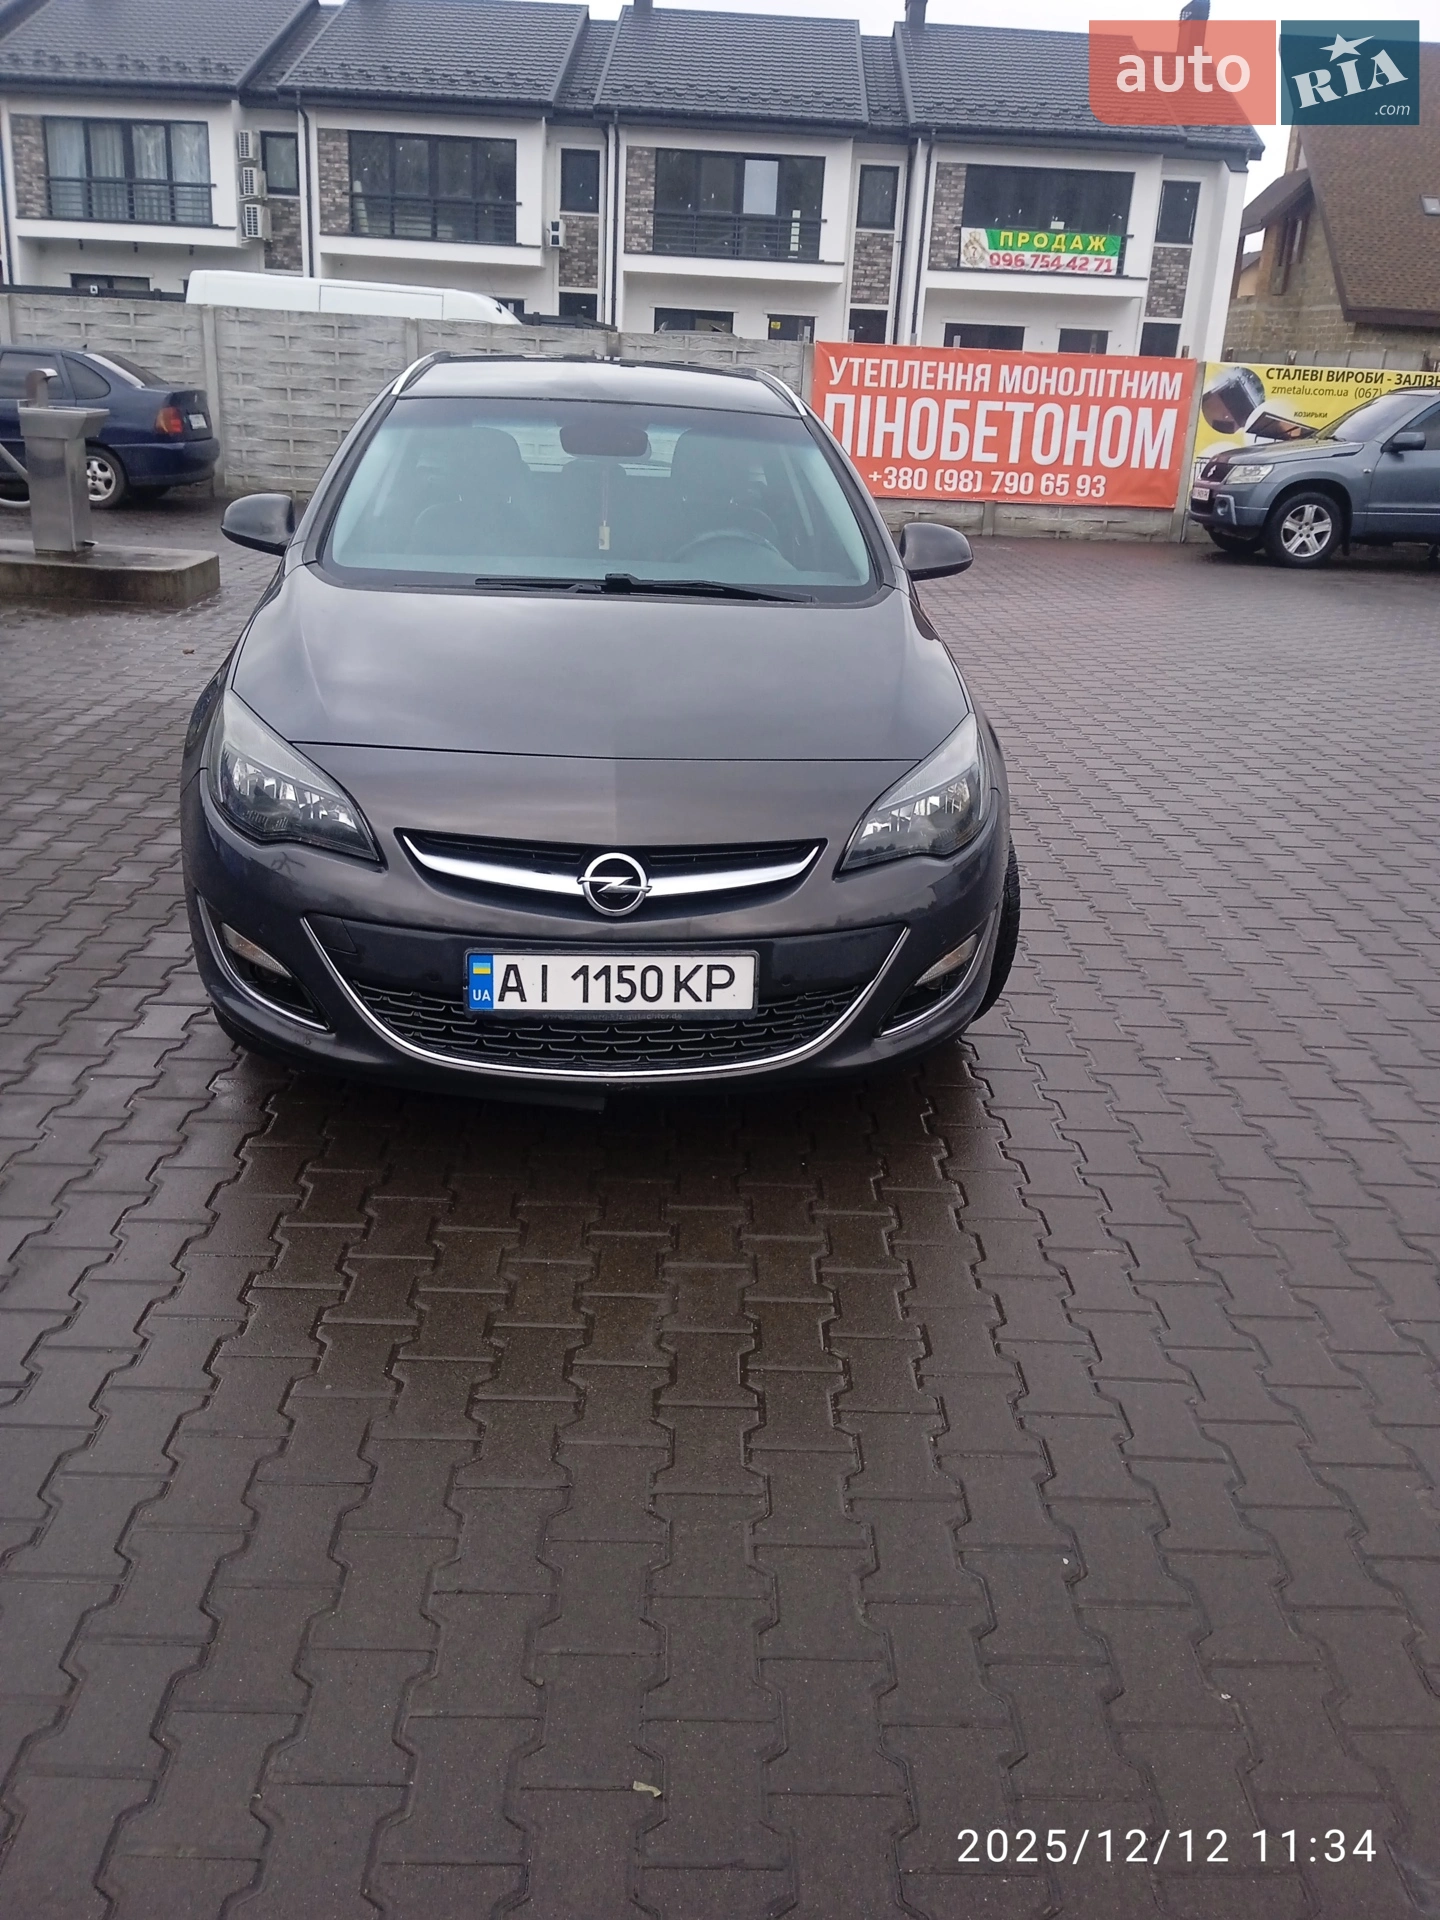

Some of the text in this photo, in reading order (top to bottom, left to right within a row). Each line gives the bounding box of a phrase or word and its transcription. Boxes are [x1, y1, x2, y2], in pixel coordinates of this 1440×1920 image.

[1000, 231, 1106, 252] ПРОДАЖ
[989, 252, 1112, 272] 096 754 42 71
[829, 356, 1183, 401] УТЕПЛЕННЯ МОНОЛІТНИМ
[1266, 367, 1324, 382] СТАЛЕВІ
[1326, 370, 1385, 384] ВИРОБИ
[1271, 385, 1349, 397] zmetalu.com.ua
[823, 393, 1178, 470] ПІНОБЕТОНОМ
[868, 466, 1107, 498] +380 (98) 790 65 93
[571, 964, 663, 1004] 1150
[472, 989, 491, 1001] UA
